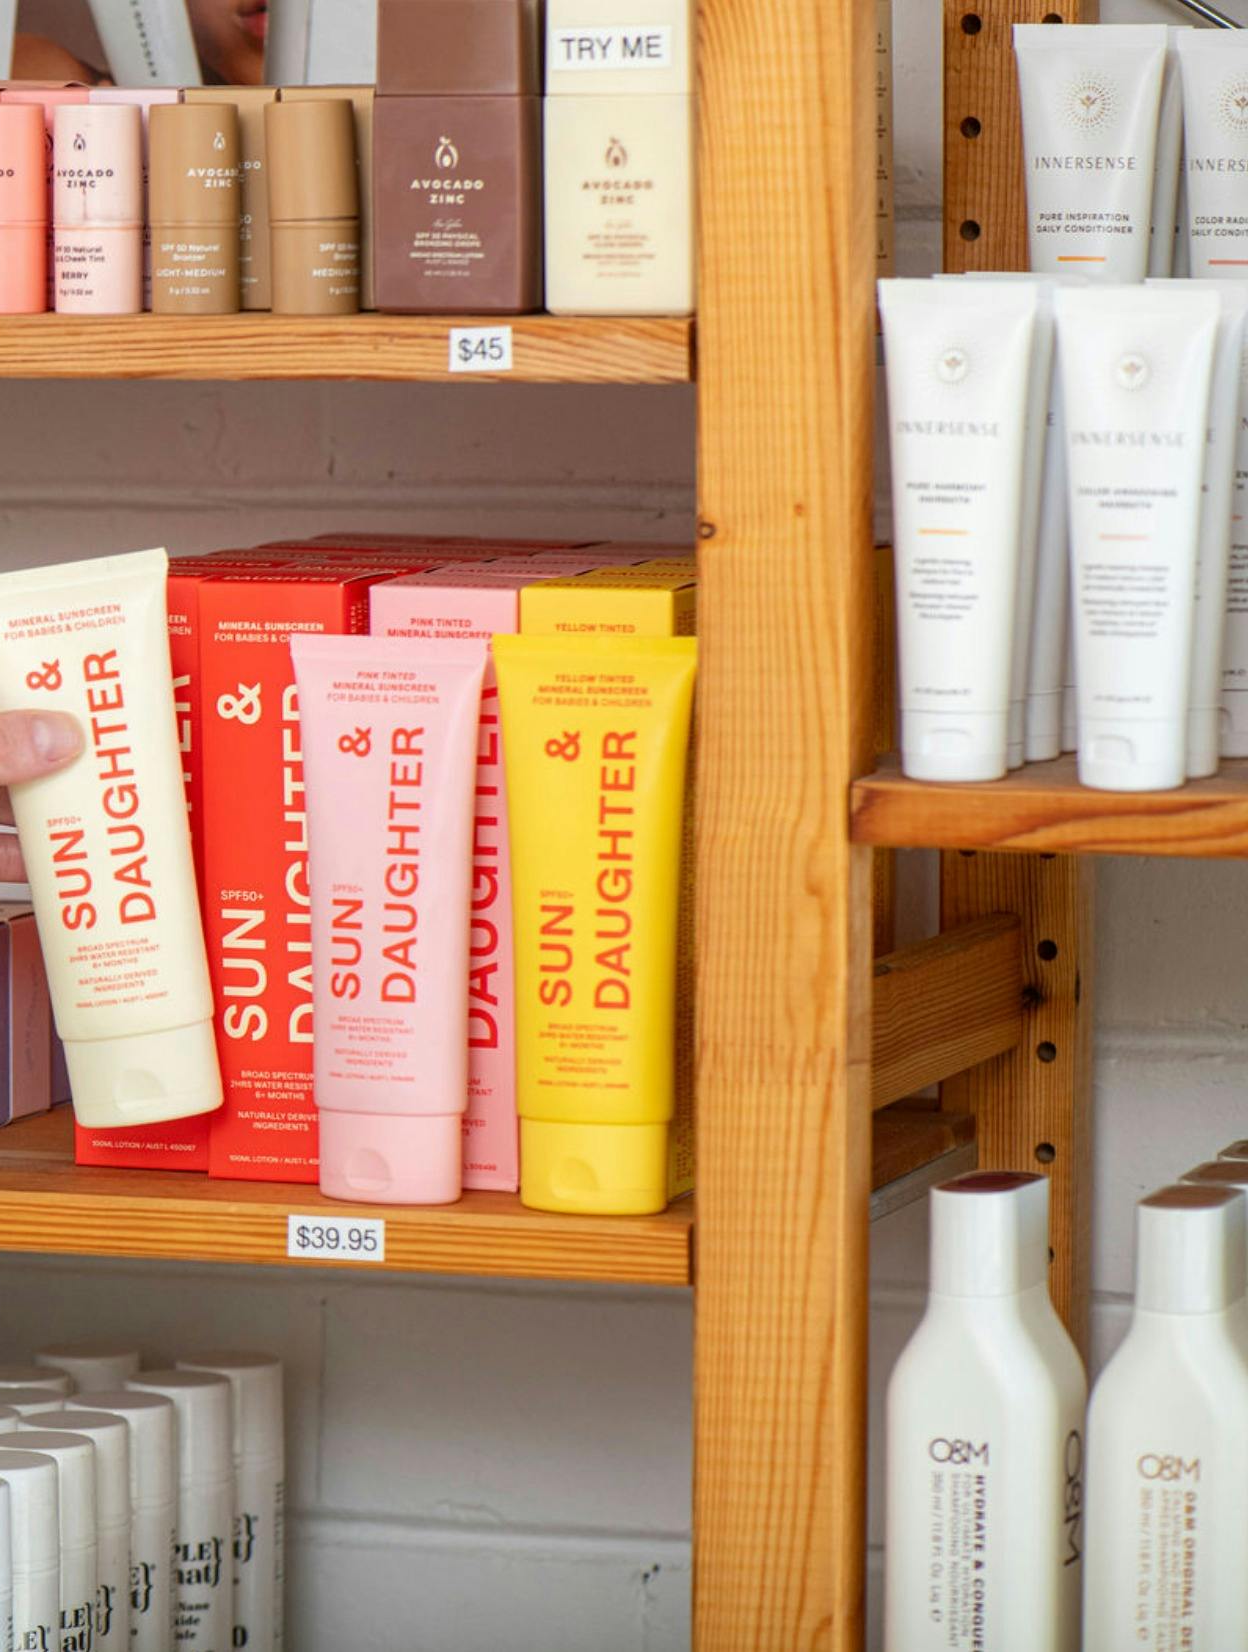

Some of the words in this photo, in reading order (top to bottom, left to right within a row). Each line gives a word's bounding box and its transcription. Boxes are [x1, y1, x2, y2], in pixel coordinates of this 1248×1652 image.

[559, 36, 613, 61] TRY
[621, 35, 662, 60] ME
[1034, 155, 1137, 172] INNERSENSE
[57, 168, 114, 177] AVOCADO
[66, 179, 97, 188] ZINC
[204, 178, 233, 188] ZINC
[410, 179, 485, 190] AVOCADO
[581, 180, 654, 190] AVOCADO
[429, 194, 465, 204] ZINC
[600, 194, 635, 205] ZINC
[1039, 212, 1063, 222] PURE
[1065, 212, 1130, 222] INSPIRATION
[1194, 215, 1224, 225] COLOR
[1036, 225, 1061, 234] DAILY
[1064, 225, 1133, 235] CONDITIONER
[61, 272, 89, 280] BERRY
[457, 337, 503, 363] $45
[8, 614, 56, 629] MINERAL
[58, 604, 122, 623] SUNSCREEN
[410, 617, 434, 627] PINK
[436, 617, 472, 628] TINTED
[4, 630, 25, 641] FOR
[27, 624, 64, 639] BABIES
[75, 615, 126, 632] CHILDREN
[218, 620, 263, 632] MINERAL
[264, 621, 324, 633] SUNSCREEN
[555, 623, 596, 633] YELLOW
[599, 624, 635, 634] TINTED
[214, 632, 234, 642] FOR
[235, 632, 269, 643] BABIES
[270, 633, 278, 643] &
[387, 628, 431, 638] MINERAL
[25, 657, 63, 691] &
[357, 671, 378, 680] PINK
[380, 671, 416, 681] TINTED
[555, 674, 595, 683] YELLOW
[599, 674, 635, 684] TINTED
[333, 681, 377, 692] MINERAL
[378, 682, 436, 692] SUNSCREEN
[538, 685, 584, 695] MINERAL
[586, 685, 648, 696] SUNSCREEN
[216, 682, 262, 725] &
[327, 692, 345, 702] FOR
[347, 692, 380, 703] BABIES
[390, 693, 440, 704] CHILDREN
[533, 696, 553, 706] FOR
[338, 726, 372, 758] &
[544, 730, 581, 763] &
[83, 649, 157, 926] DAUGHTER
[47, 816, 83, 828] SPF50+
[380, 726, 425, 1003] DAUGHTER
[594, 730, 638, 1010] DAUGHTER
[49, 829, 98, 931] SUN
[220, 889, 264, 902] SPF50+
[105, 937, 149, 950] SPECTRUM
[331, 899, 363, 1001] SUN
[539, 904, 575, 1008] SUN
[103, 956, 139, 968] MONTHS
[123, 969, 158, 981] DERIVED
[220, 907, 269, 1041] SUN
[240, 1070, 271, 1080] BROAD
[230, 1080, 252, 1090] 2HRS
[253, 1081, 278, 1090] WATER
[267, 1091, 305, 1101] MONTHS
[238, 1111, 286, 1121] NATURALLY
[253, 1121, 309, 1132] INGREDIENTS
[115, 1140, 140, 1149] LOTION
[252, 1155, 278, 1164] LOTION
[296, 1225, 377, 1252] $39.95
[929, 1437, 990, 1466] O&M
[1137, 1453, 1201, 1483] O&M
[973, 1473, 986, 1553] HYDRATE
[1181, 1536, 1196, 1618] ORIGINAL
